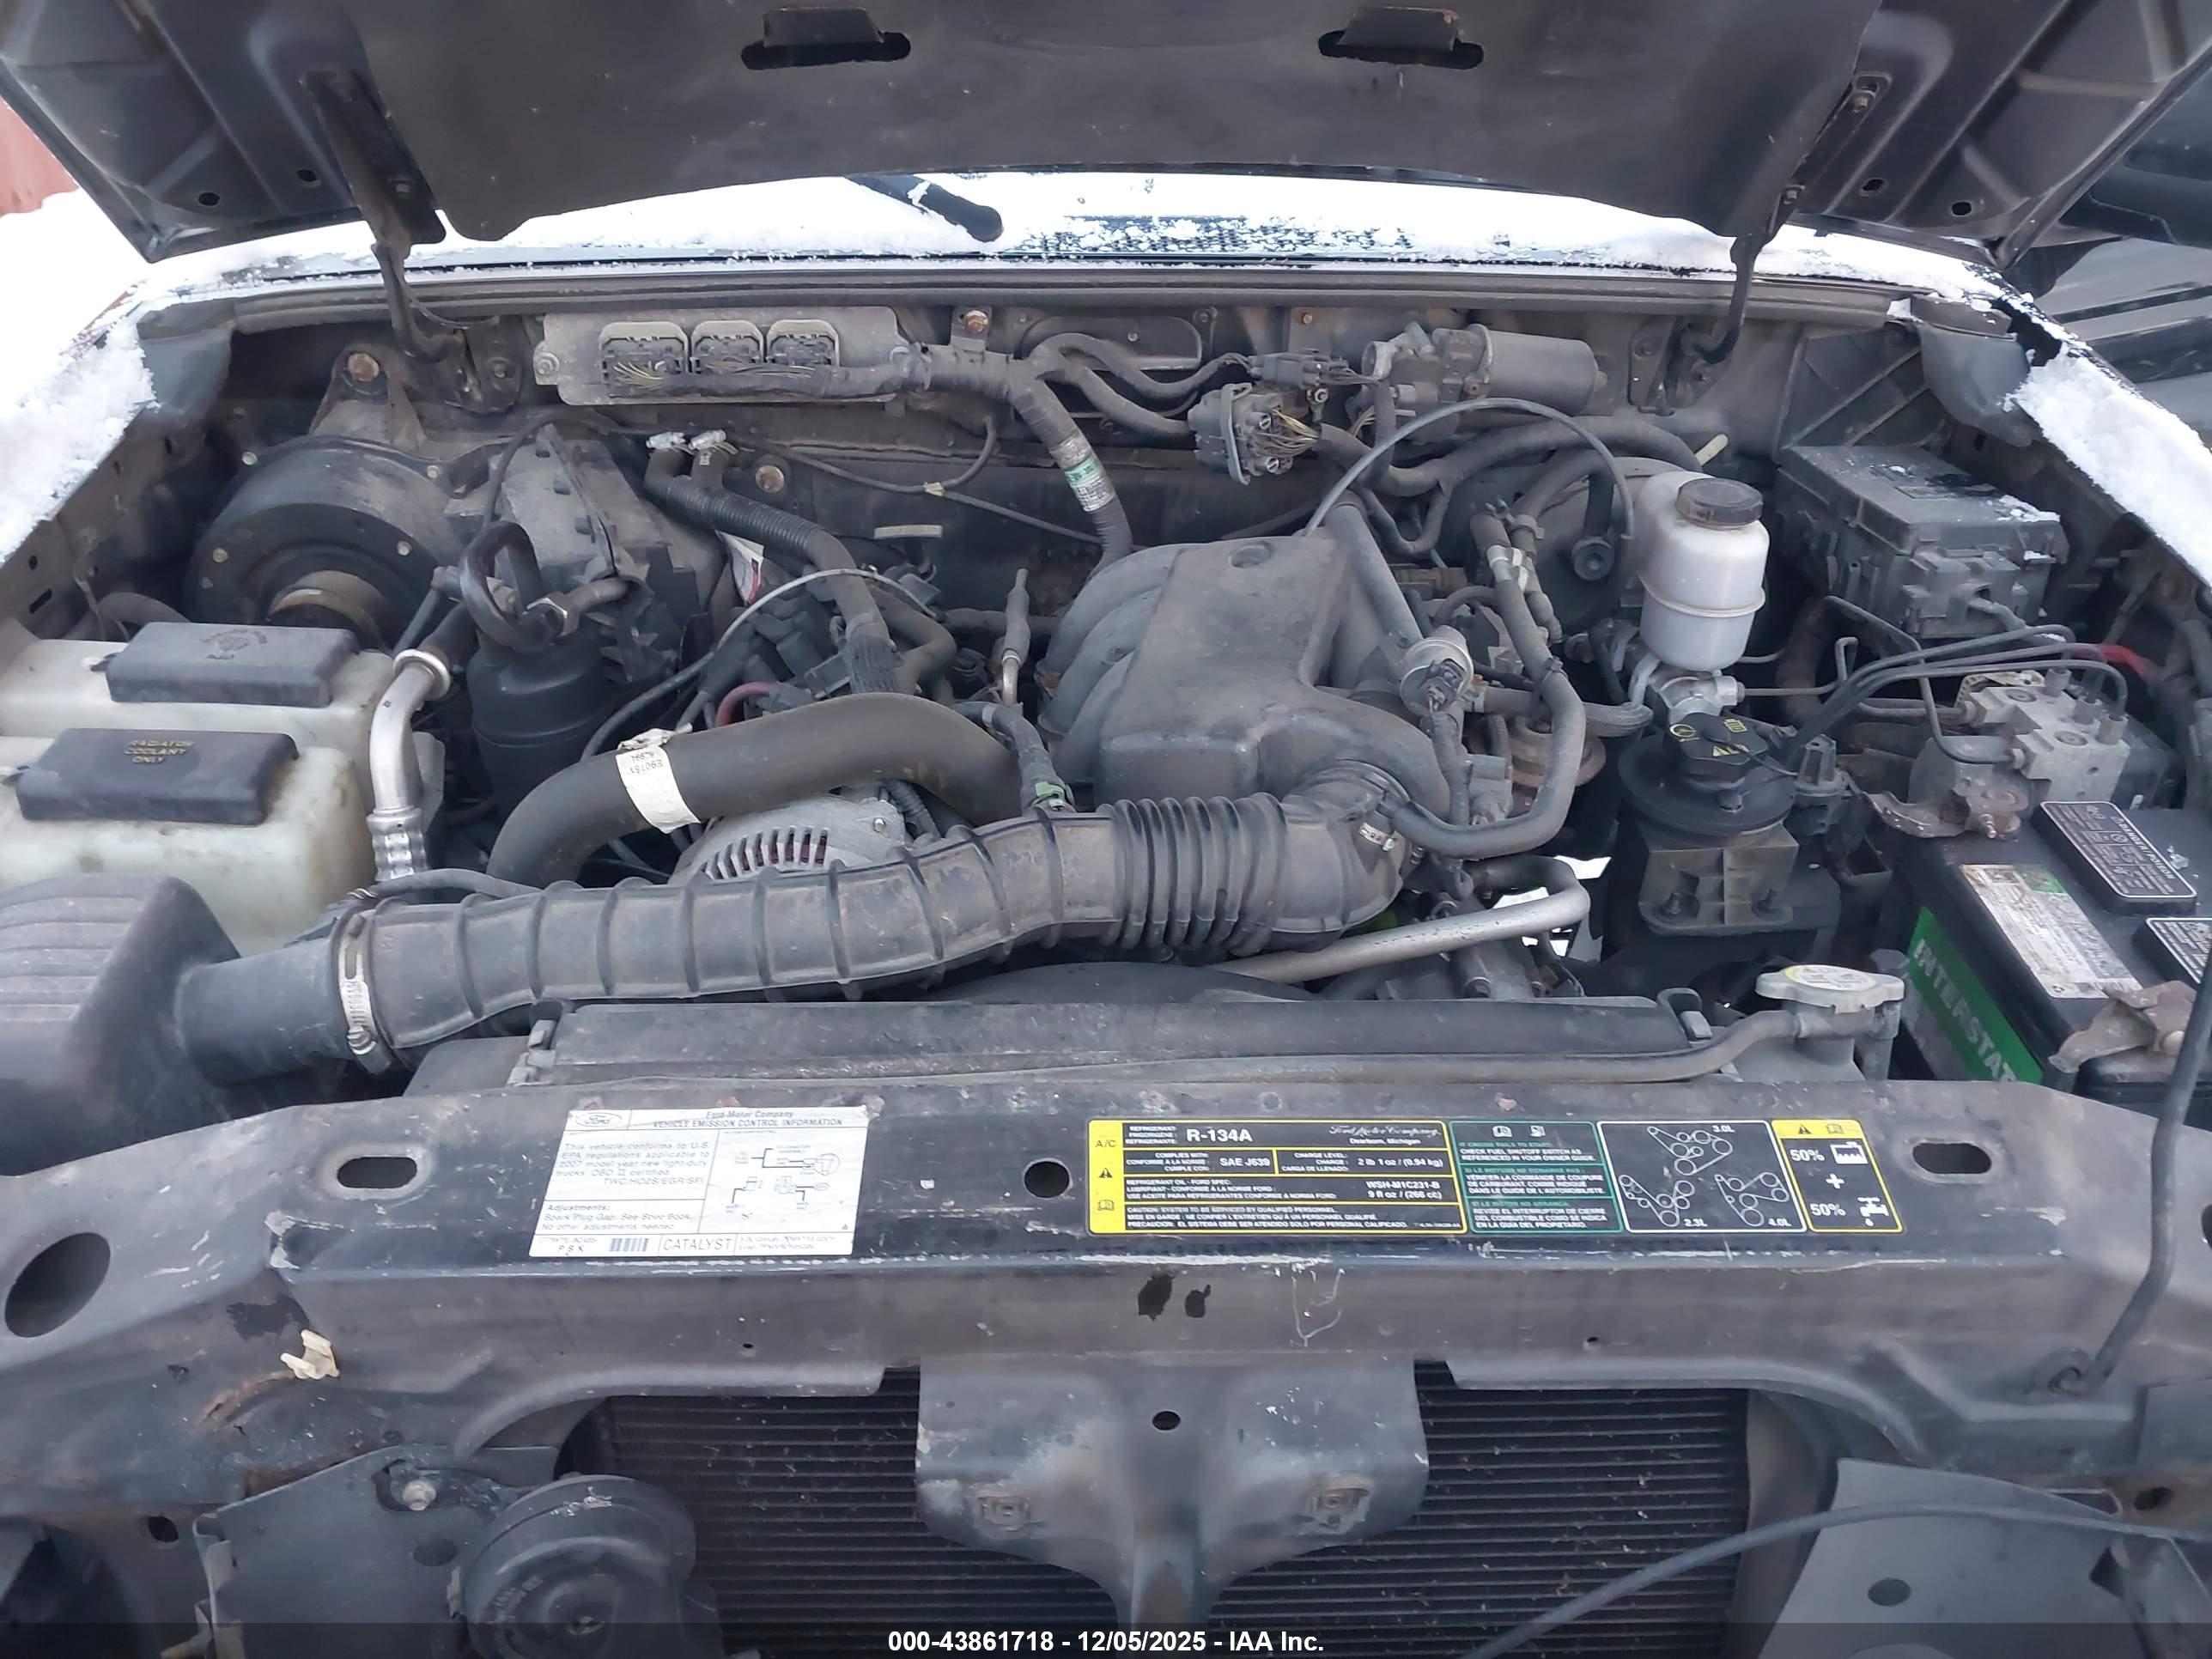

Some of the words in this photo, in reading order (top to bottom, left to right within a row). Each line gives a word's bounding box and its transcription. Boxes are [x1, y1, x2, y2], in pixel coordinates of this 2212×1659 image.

[707, 1110, 724, 1119] Ford
[728, 1110, 753, 1119] Motor
[754, 1110, 793, 1119] Company
[653, 1120, 689, 1128] VEHICLE
[692, 1119, 735, 1127] EMISSION
[1186, 1128, 1253, 1142] R-134A
[1790, 1149, 1826, 1161] 50%
[1219, 1158, 1243, 1167] SAE
[1244, 1158, 1271, 1167] J639
[1402, 1158, 1426, 1168] (0.94
[1427, 1158, 1443, 1168] kg)
[1366, 1181, 1441, 1189] WSH-M1C231-B
[1404, 1190, 1426, 1200] (266
[1425, 1190, 1443, 1200] cc)
[1809, 1203, 1847, 1216] 50%
[1683, 1218, 1708, 1227] 2.3L
[1767, 1218, 1792, 1227] 4.0L
[663, 1238, 732, 1250] CATALYST
